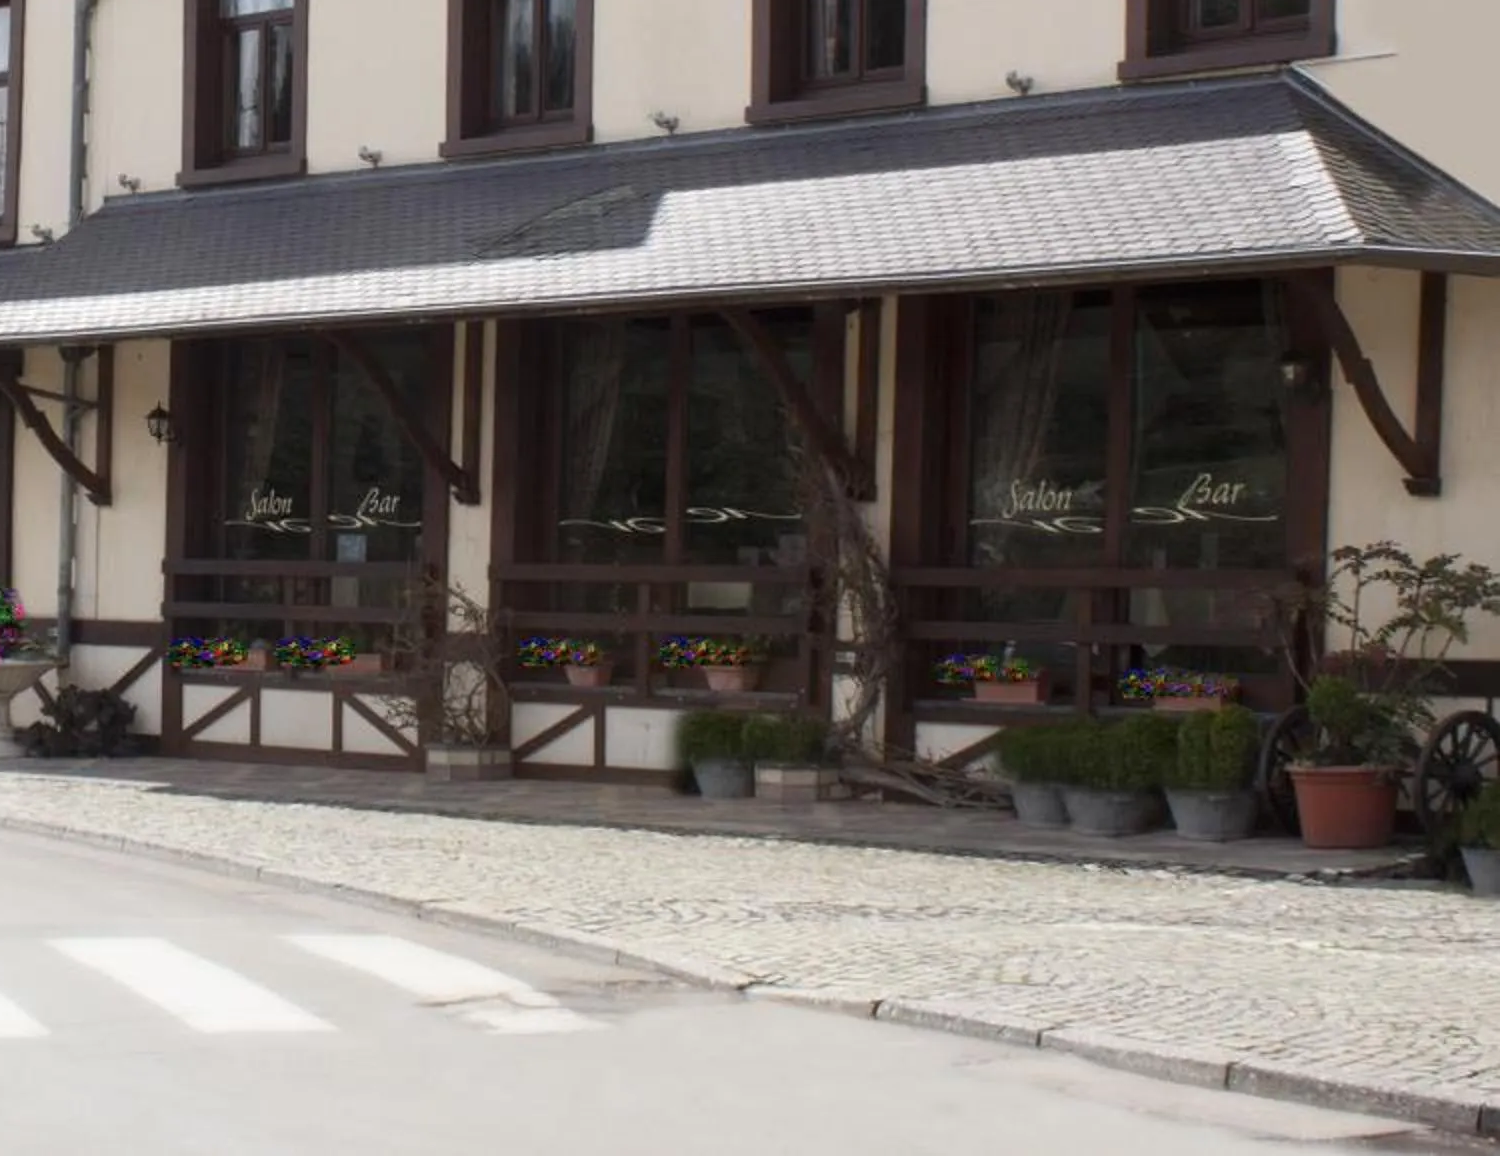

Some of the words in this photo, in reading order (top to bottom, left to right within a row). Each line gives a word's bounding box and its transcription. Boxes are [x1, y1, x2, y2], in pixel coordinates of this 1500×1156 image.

[246, 488, 293, 521] Salon
[356, 487, 400, 520] Bar
[1002, 478, 1073, 519] Salon
[1177, 472, 1246, 514] Bar
